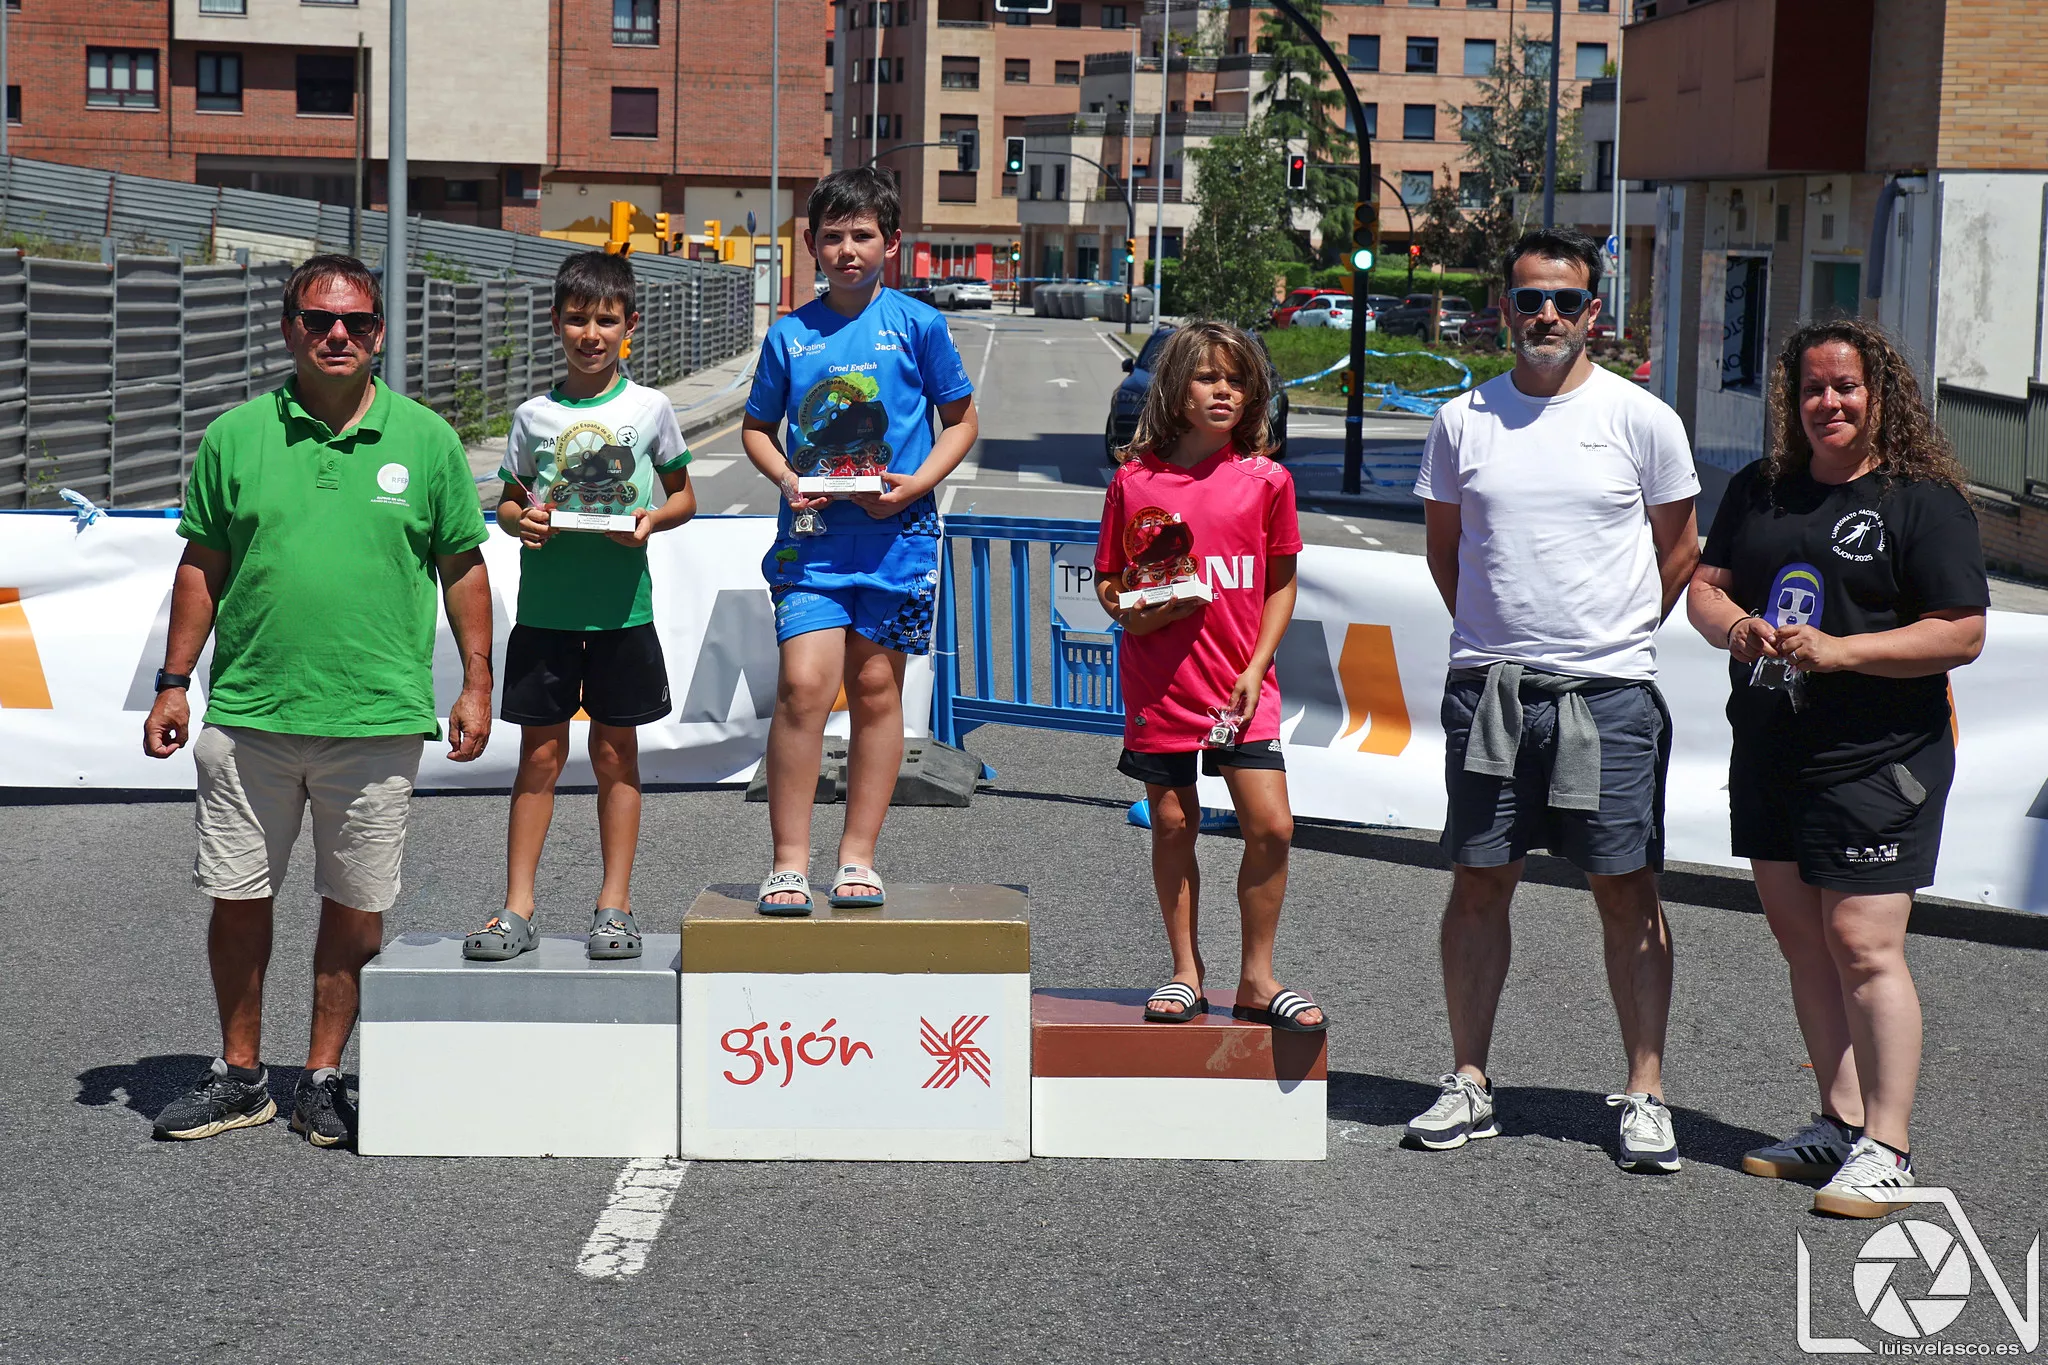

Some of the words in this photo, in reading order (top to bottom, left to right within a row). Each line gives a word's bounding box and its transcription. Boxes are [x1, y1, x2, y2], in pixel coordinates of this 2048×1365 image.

[874, 343, 897, 351] Jaca
[829, 364, 850, 373] Oroel
[850, 361, 878, 372] English
[560, 430, 573, 442] Copa
[579, 422, 601, 430] España
[1831, 512, 1857, 538] CAMPEONATO
[1854, 553, 1873, 561] 2025
[1845, 844, 1899, 858] SANI
[768, 873, 804, 887] NASA
[720, 1018, 874, 1088] gijón
